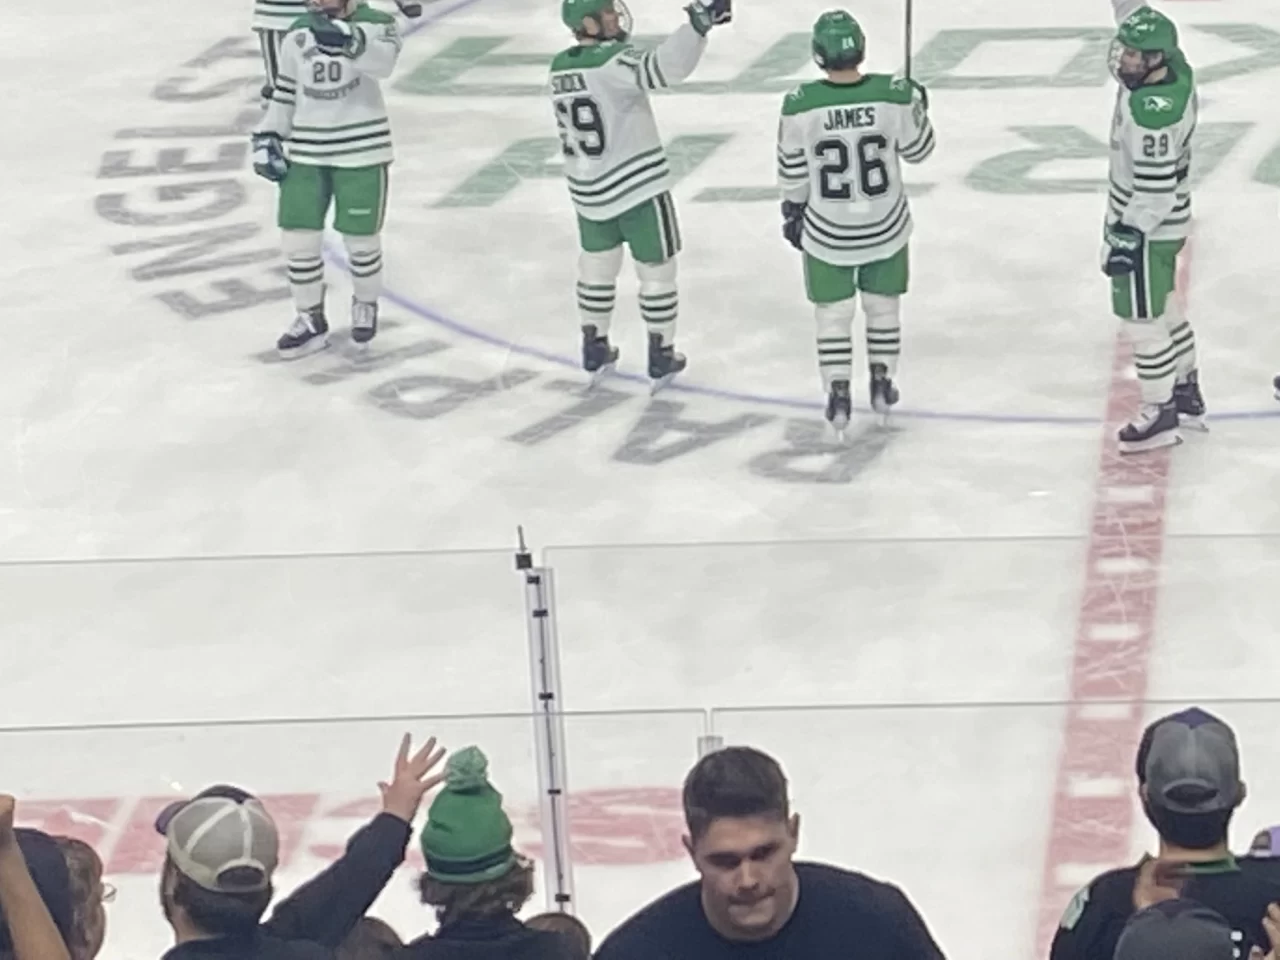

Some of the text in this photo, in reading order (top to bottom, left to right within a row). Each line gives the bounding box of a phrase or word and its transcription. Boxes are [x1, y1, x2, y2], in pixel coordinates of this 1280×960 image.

[313, 60, 342, 83] 20
[824, 106, 876, 131] JAMES
[1142, 133, 1169, 158] 29
[812, 134, 890, 201] 26
